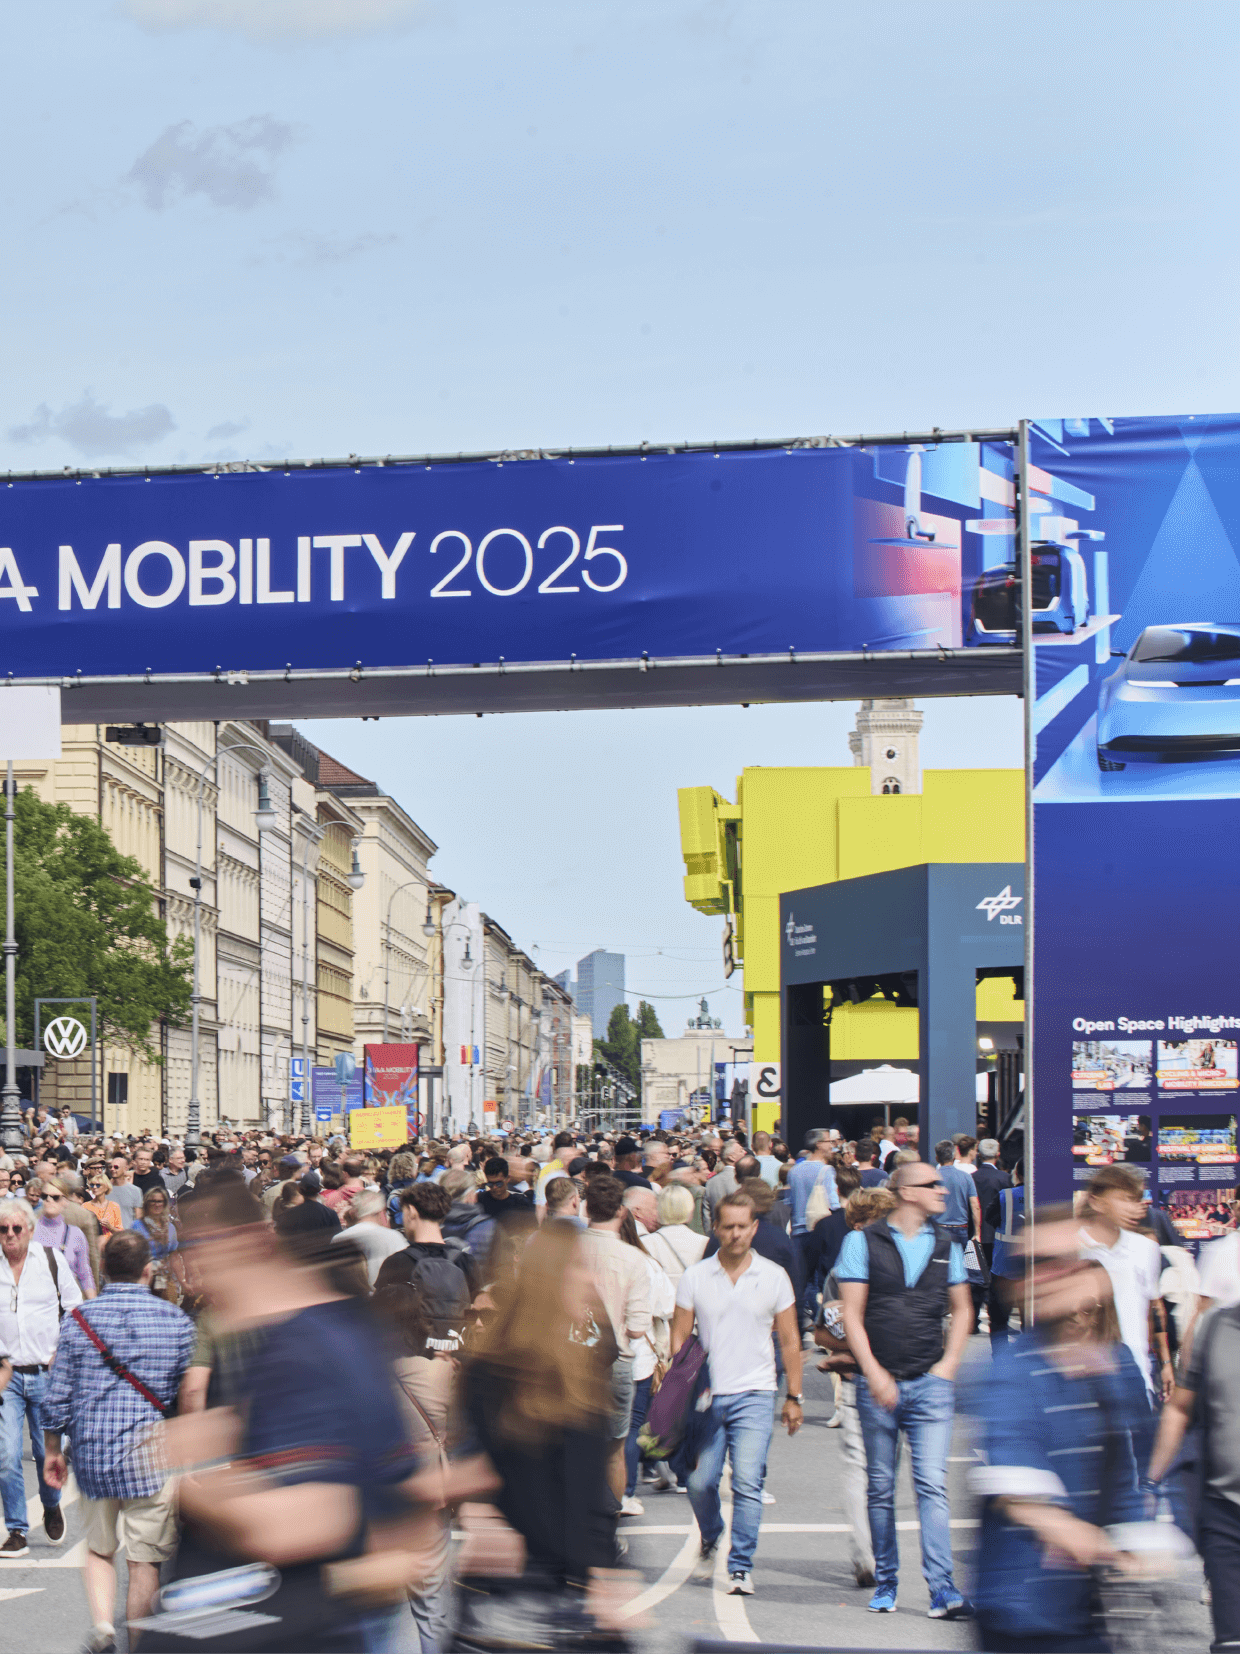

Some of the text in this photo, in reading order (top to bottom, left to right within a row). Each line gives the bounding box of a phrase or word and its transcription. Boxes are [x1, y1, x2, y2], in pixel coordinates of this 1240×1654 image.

[58, 532, 416, 610] MOBILITY
[429, 524, 628, 597] 2025
[1000, 915, 1023, 925] DLR
[44, 1016, 87, 1059] VW
[1072, 1015, 1240, 1034] Open Space Highlights
